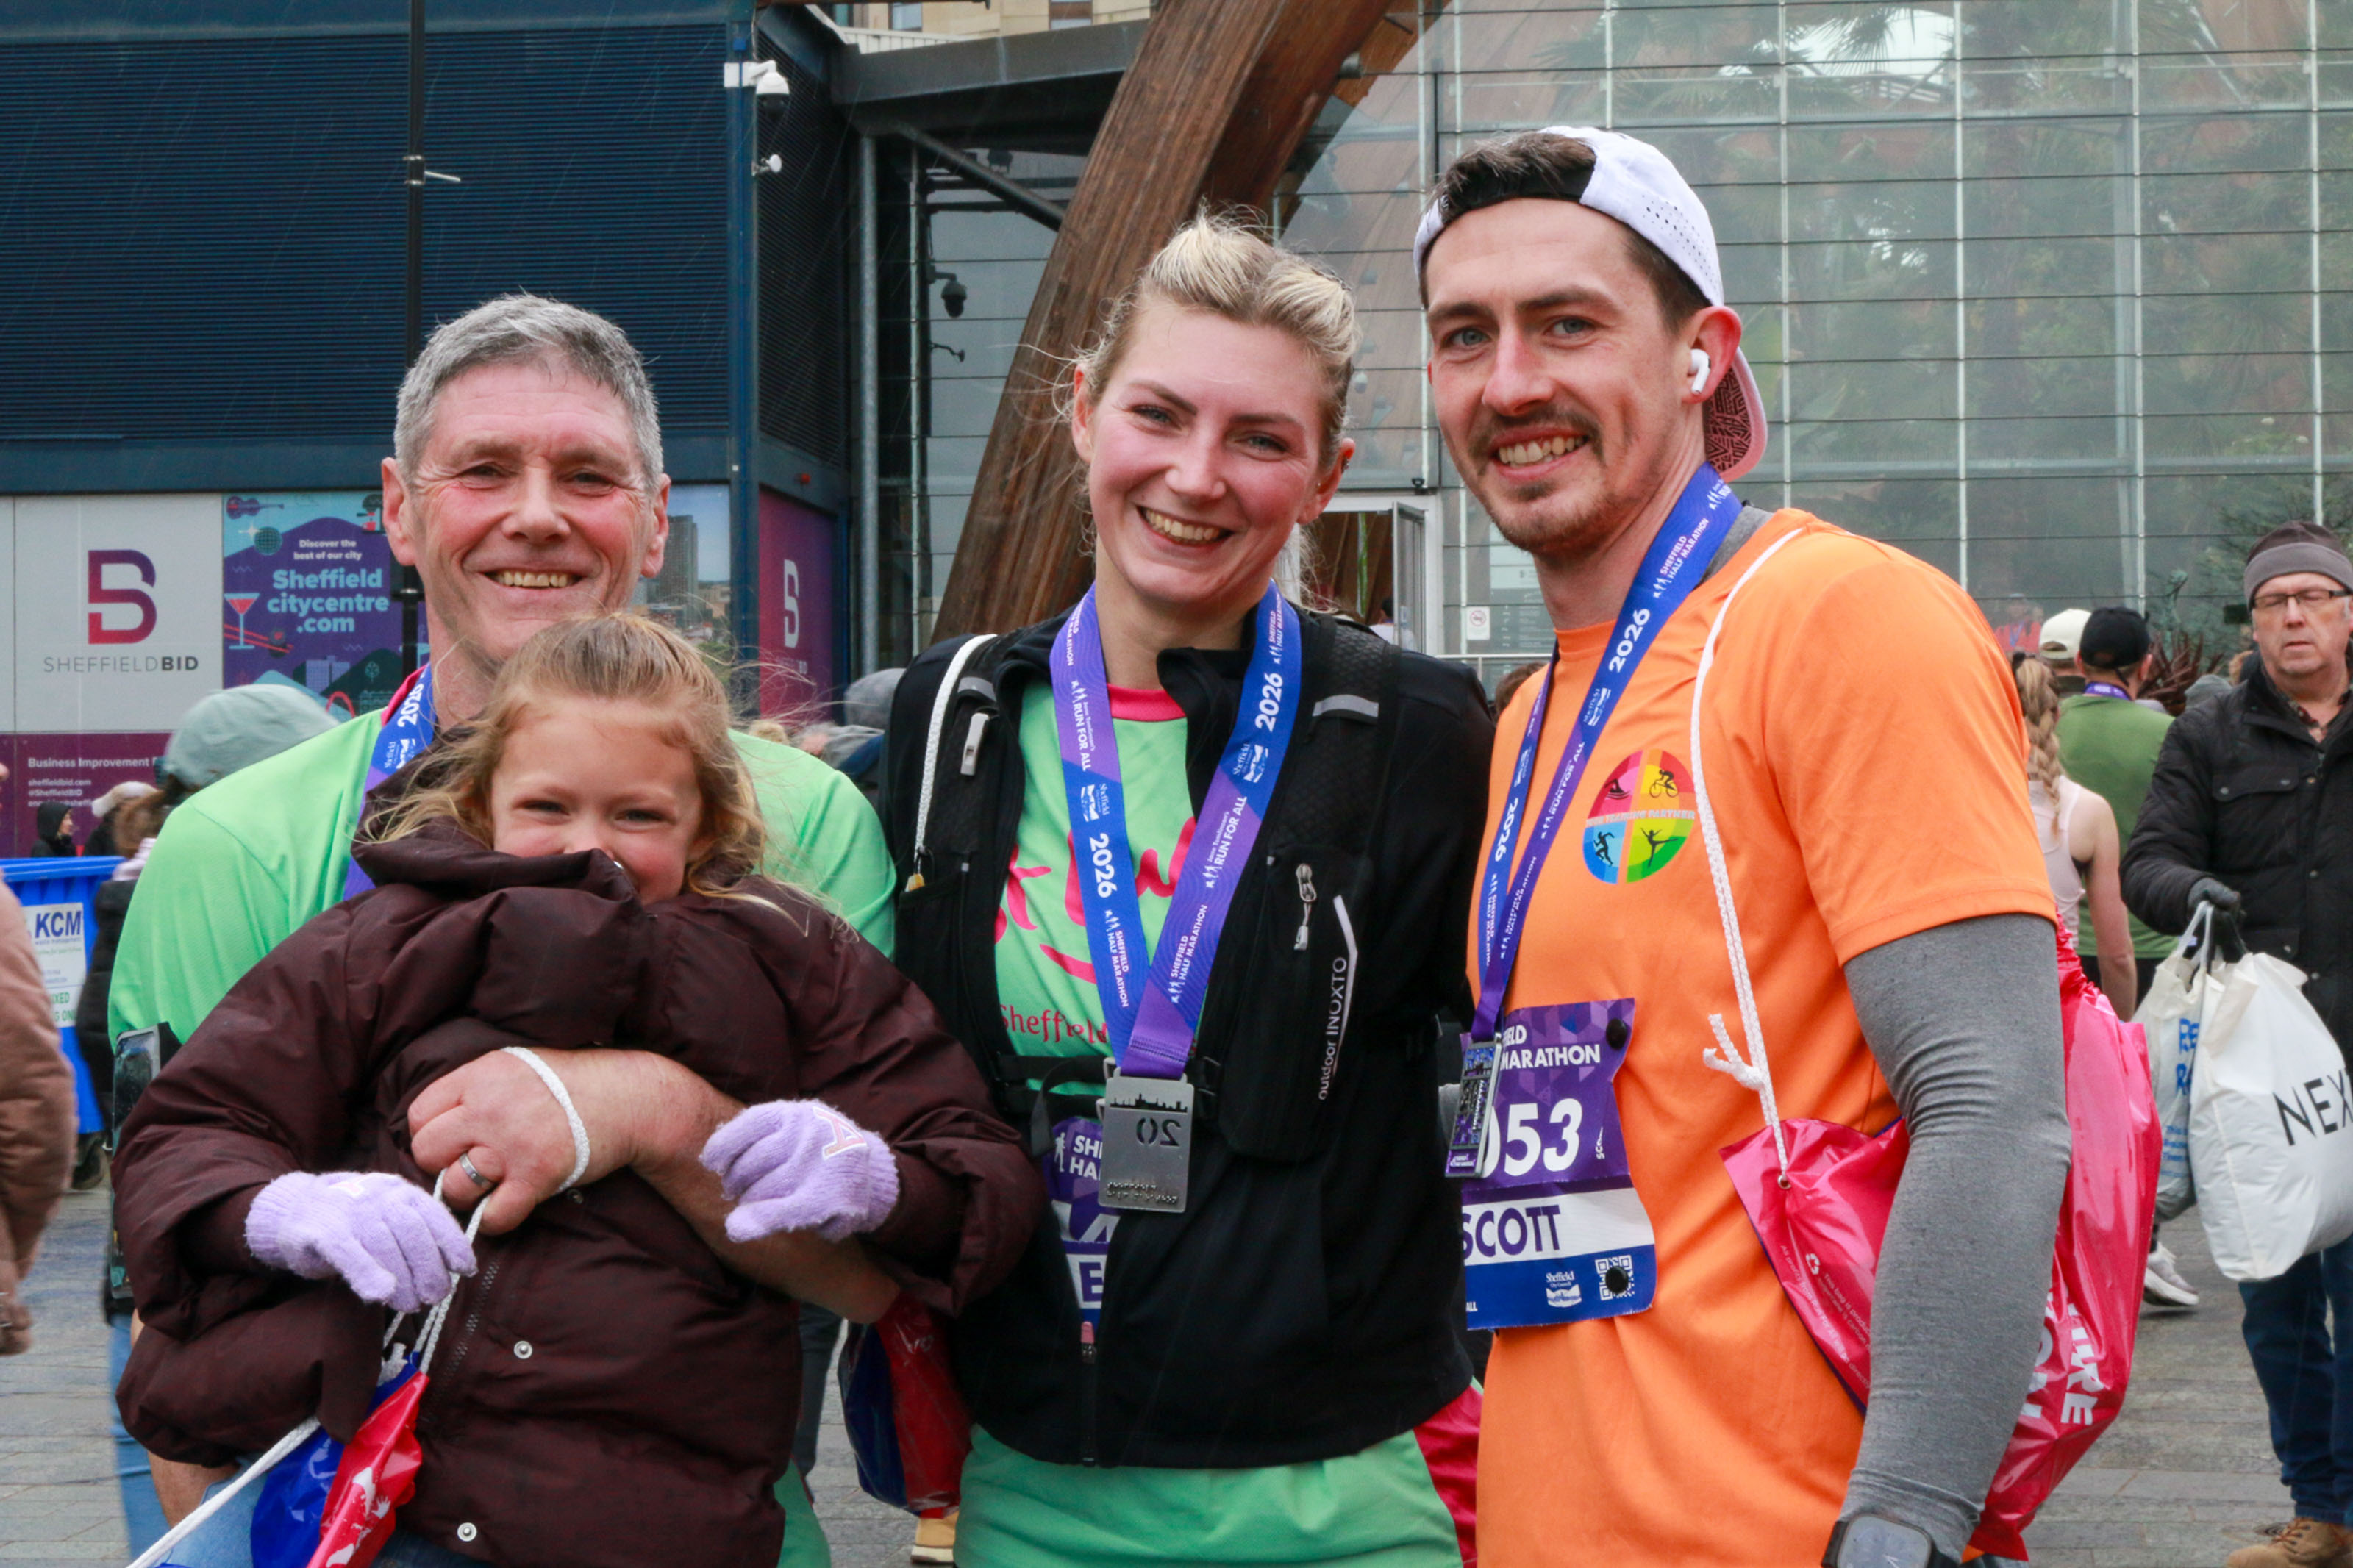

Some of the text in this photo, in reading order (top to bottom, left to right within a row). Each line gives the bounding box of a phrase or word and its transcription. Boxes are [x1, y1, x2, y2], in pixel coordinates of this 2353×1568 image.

[293, 551, 314, 560] best
[315, 551, 326, 559] of
[344, 551, 362, 561] city
[299, 539, 357, 548] Discover the
[1660, 535, 1687, 575] SHEFFIELD
[1667, 517, 1710, 579] HALF MARATHON
[273, 567, 382, 590] Sheffield
[267, 592, 389, 617] citycentre
[296, 616, 354, 633] .com
[1608, 609, 1650, 673] 2026
[1255, 673, 1283, 732] 2026
[1073, 702, 1091, 772] RUN FOR ALL
[1574, 742, 1585, 762] ALL
[28, 757, 149, 769] Business Improvement
[1215, 796, 1247, 866] RUN FOR ALL
[1495, 798, 1518, 862] 2026
[1090, 833, 1117, 898] 2026
[35, 910, 82, 938] KCM
[1179, 904, 1207, 980] HALF MARATHON
[1107, 932, 1129, 1008] HALF MARATHON
[1115, 930, 1129, 972] SHEFFIELD
[1171, 935, 1188, 978] SHEFFIELD
[1318, 957, 1347, 1100] outdoor INOXTO
[1463, 1204, 1560, 1261] SCOTT
[1546, 1270, 1575, 1284] Sheffield
